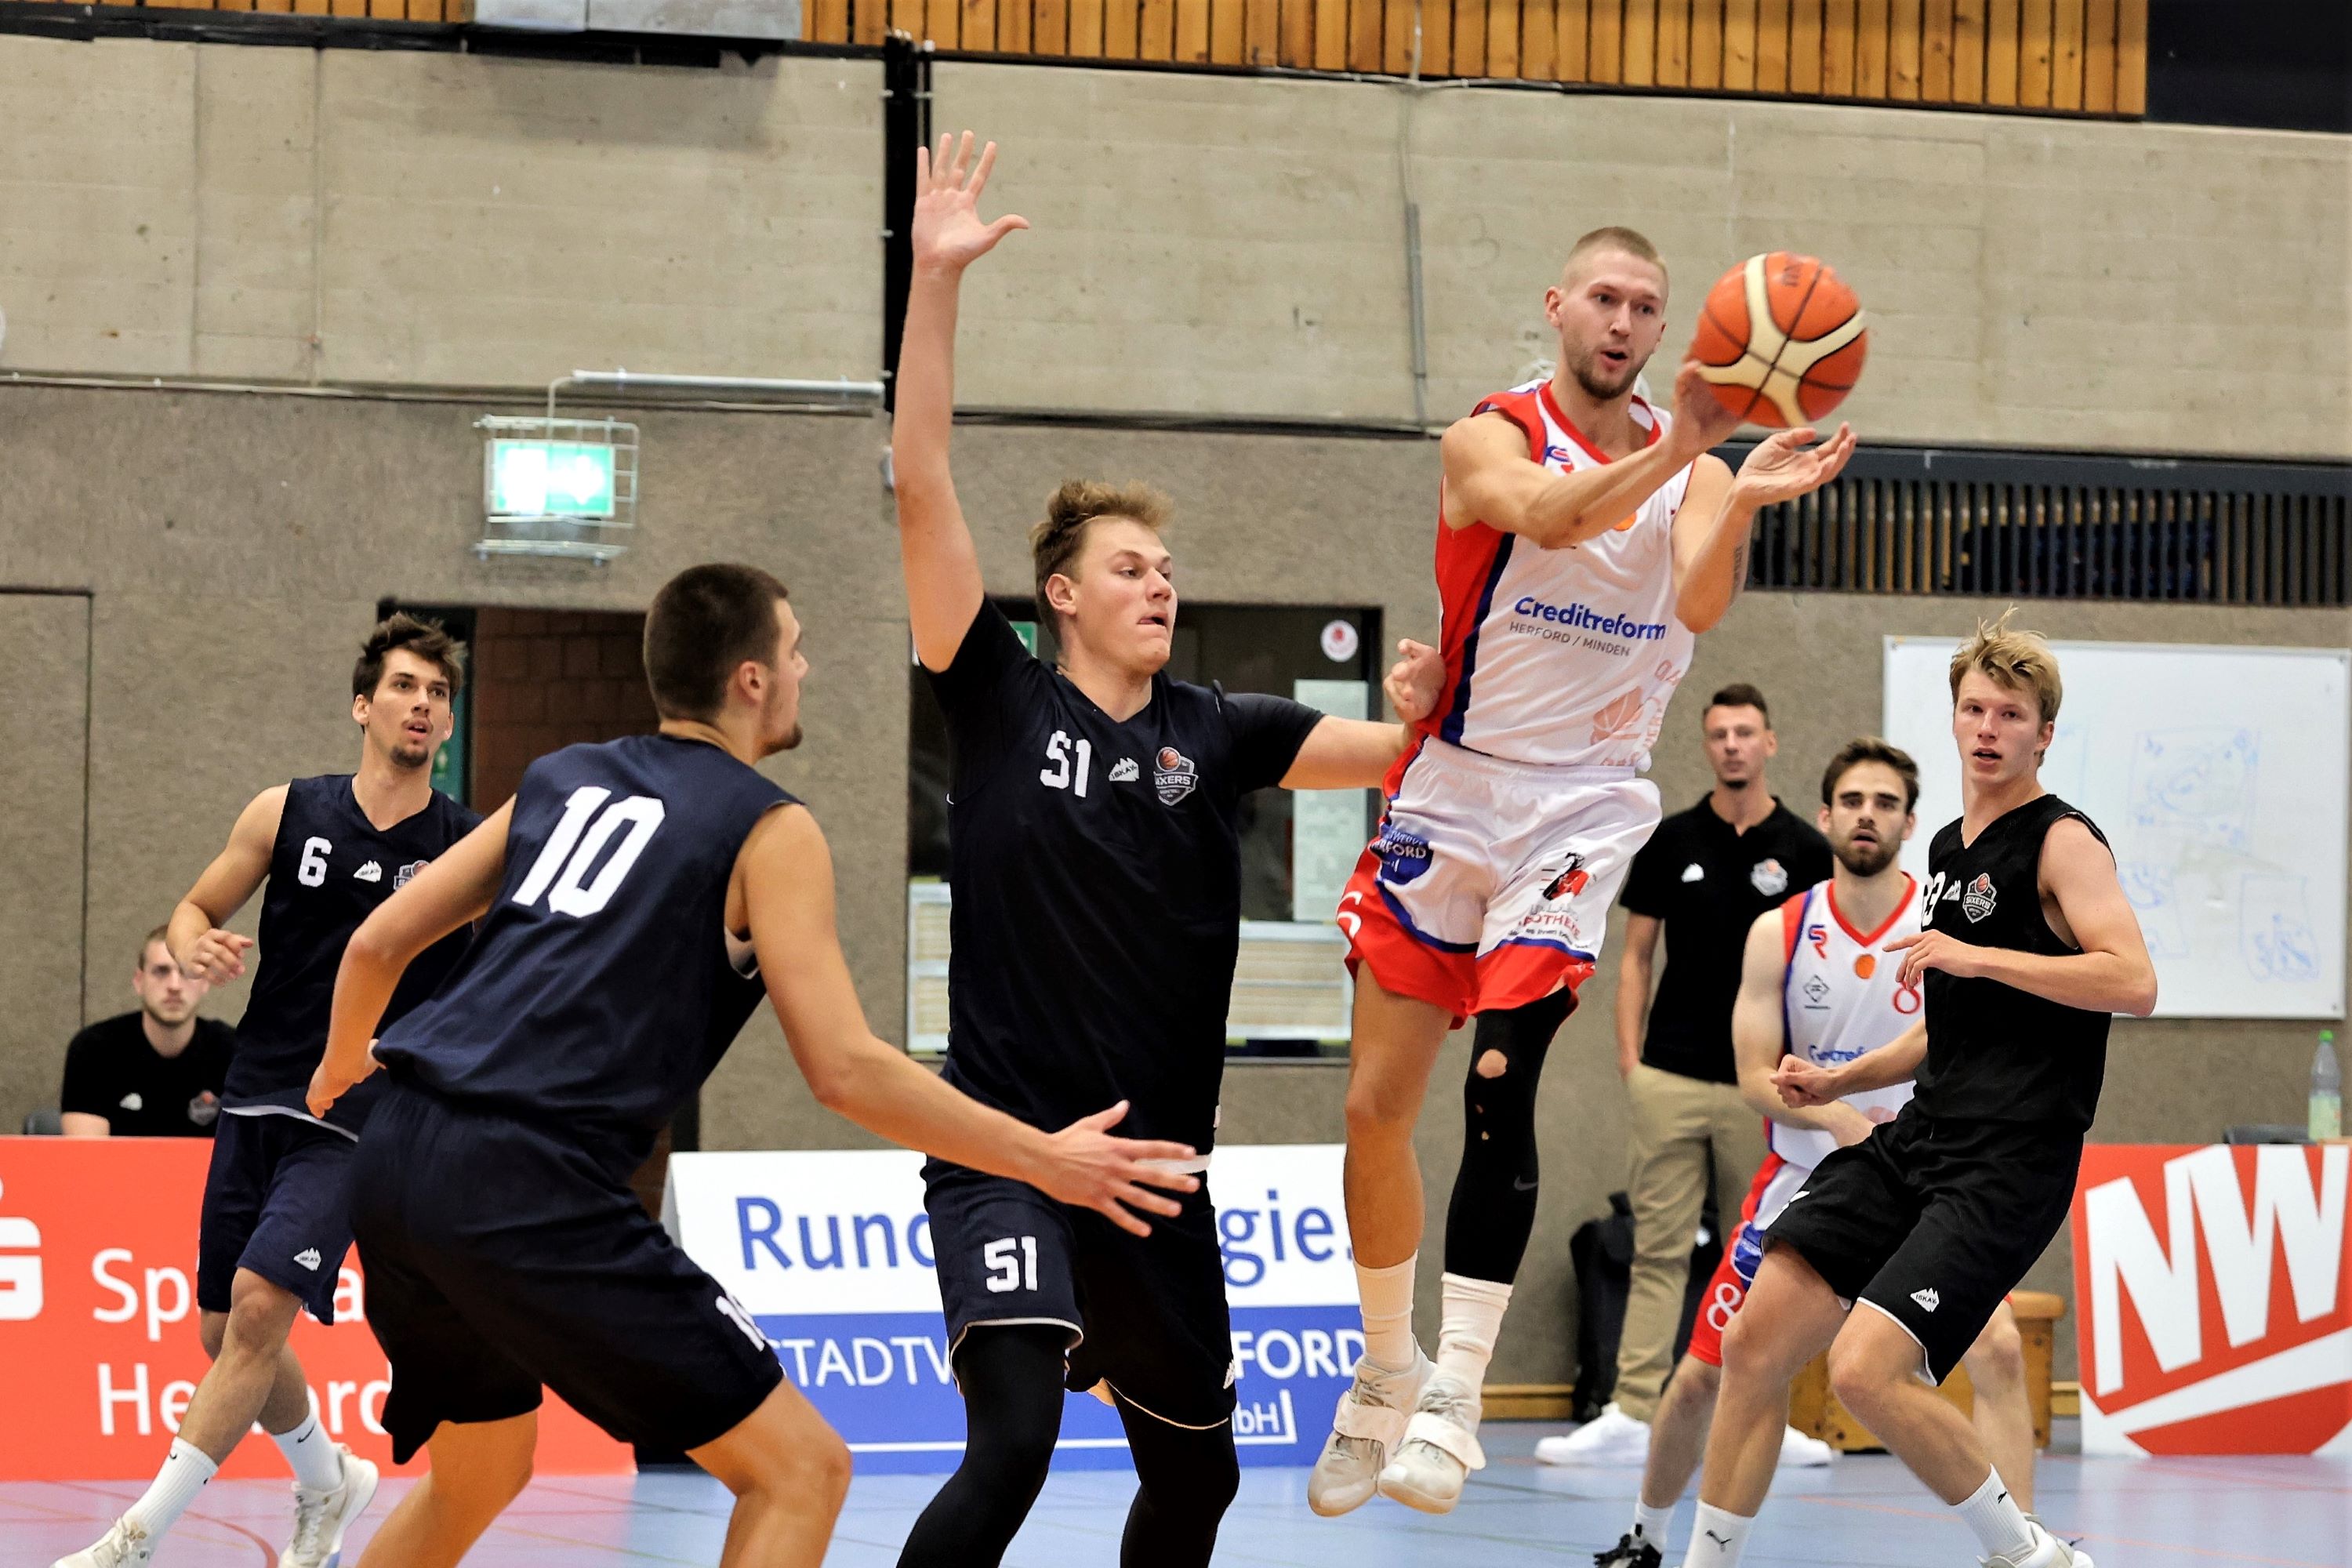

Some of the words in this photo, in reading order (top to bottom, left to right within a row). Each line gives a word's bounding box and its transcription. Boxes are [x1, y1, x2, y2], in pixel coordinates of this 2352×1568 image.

[1509, 622, 1571, 644] HERFORD
[1582, 637, 1631, 658] MINDEN
[1515, 597, 1667, 641] Creditreform
[1040, 730, 1092, 798] 51
[298, 836, 333, 888] 6
[511, 786, 666, 918] 10
[984, 1235, 1038, 1294] 51
[1219, 1189, 1353, 1288] gie.
[2085, 1144, 2350, 1397] NW
[715, 1294, 768, 1352] 1
[1706, 1282, 1741, 1331] 8
[1232, 1329, 1367, 1380] FORD
[1233, 1401, 1281, 1435] bH
